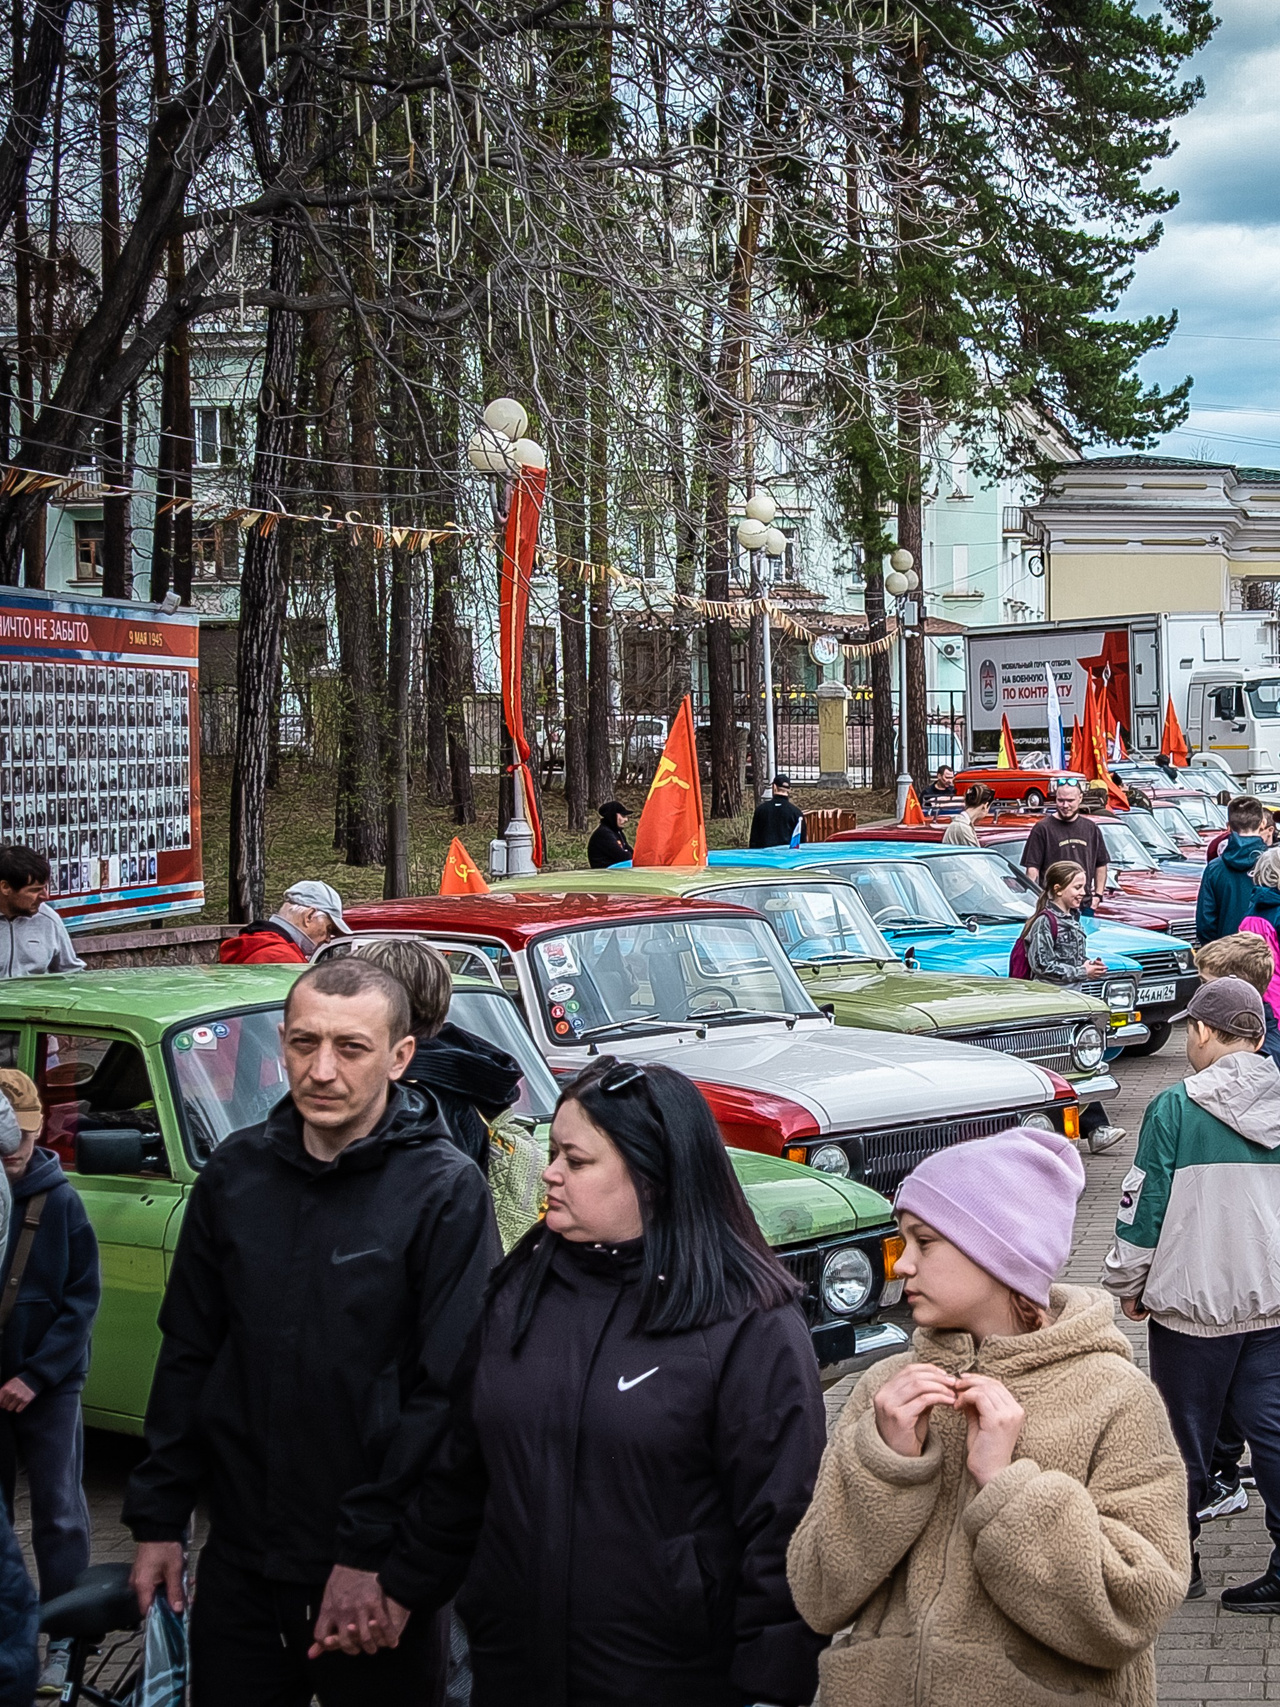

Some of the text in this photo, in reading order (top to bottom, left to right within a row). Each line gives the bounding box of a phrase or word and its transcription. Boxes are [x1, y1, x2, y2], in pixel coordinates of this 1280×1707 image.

[34, 618, 47, 640] НЕ
[50, 619, 89, 643] ЗАБЫТО
[129, 631, 163, 647] 9 МАЯ 1945
[1002, 675, 1011, 684] НА
[1012, 673, 1043, 683] ВОЕННУЮ
[1003, 688, 1016, 700] ПО
[1018, 685, 1072, 699] КОНТРКТУ
